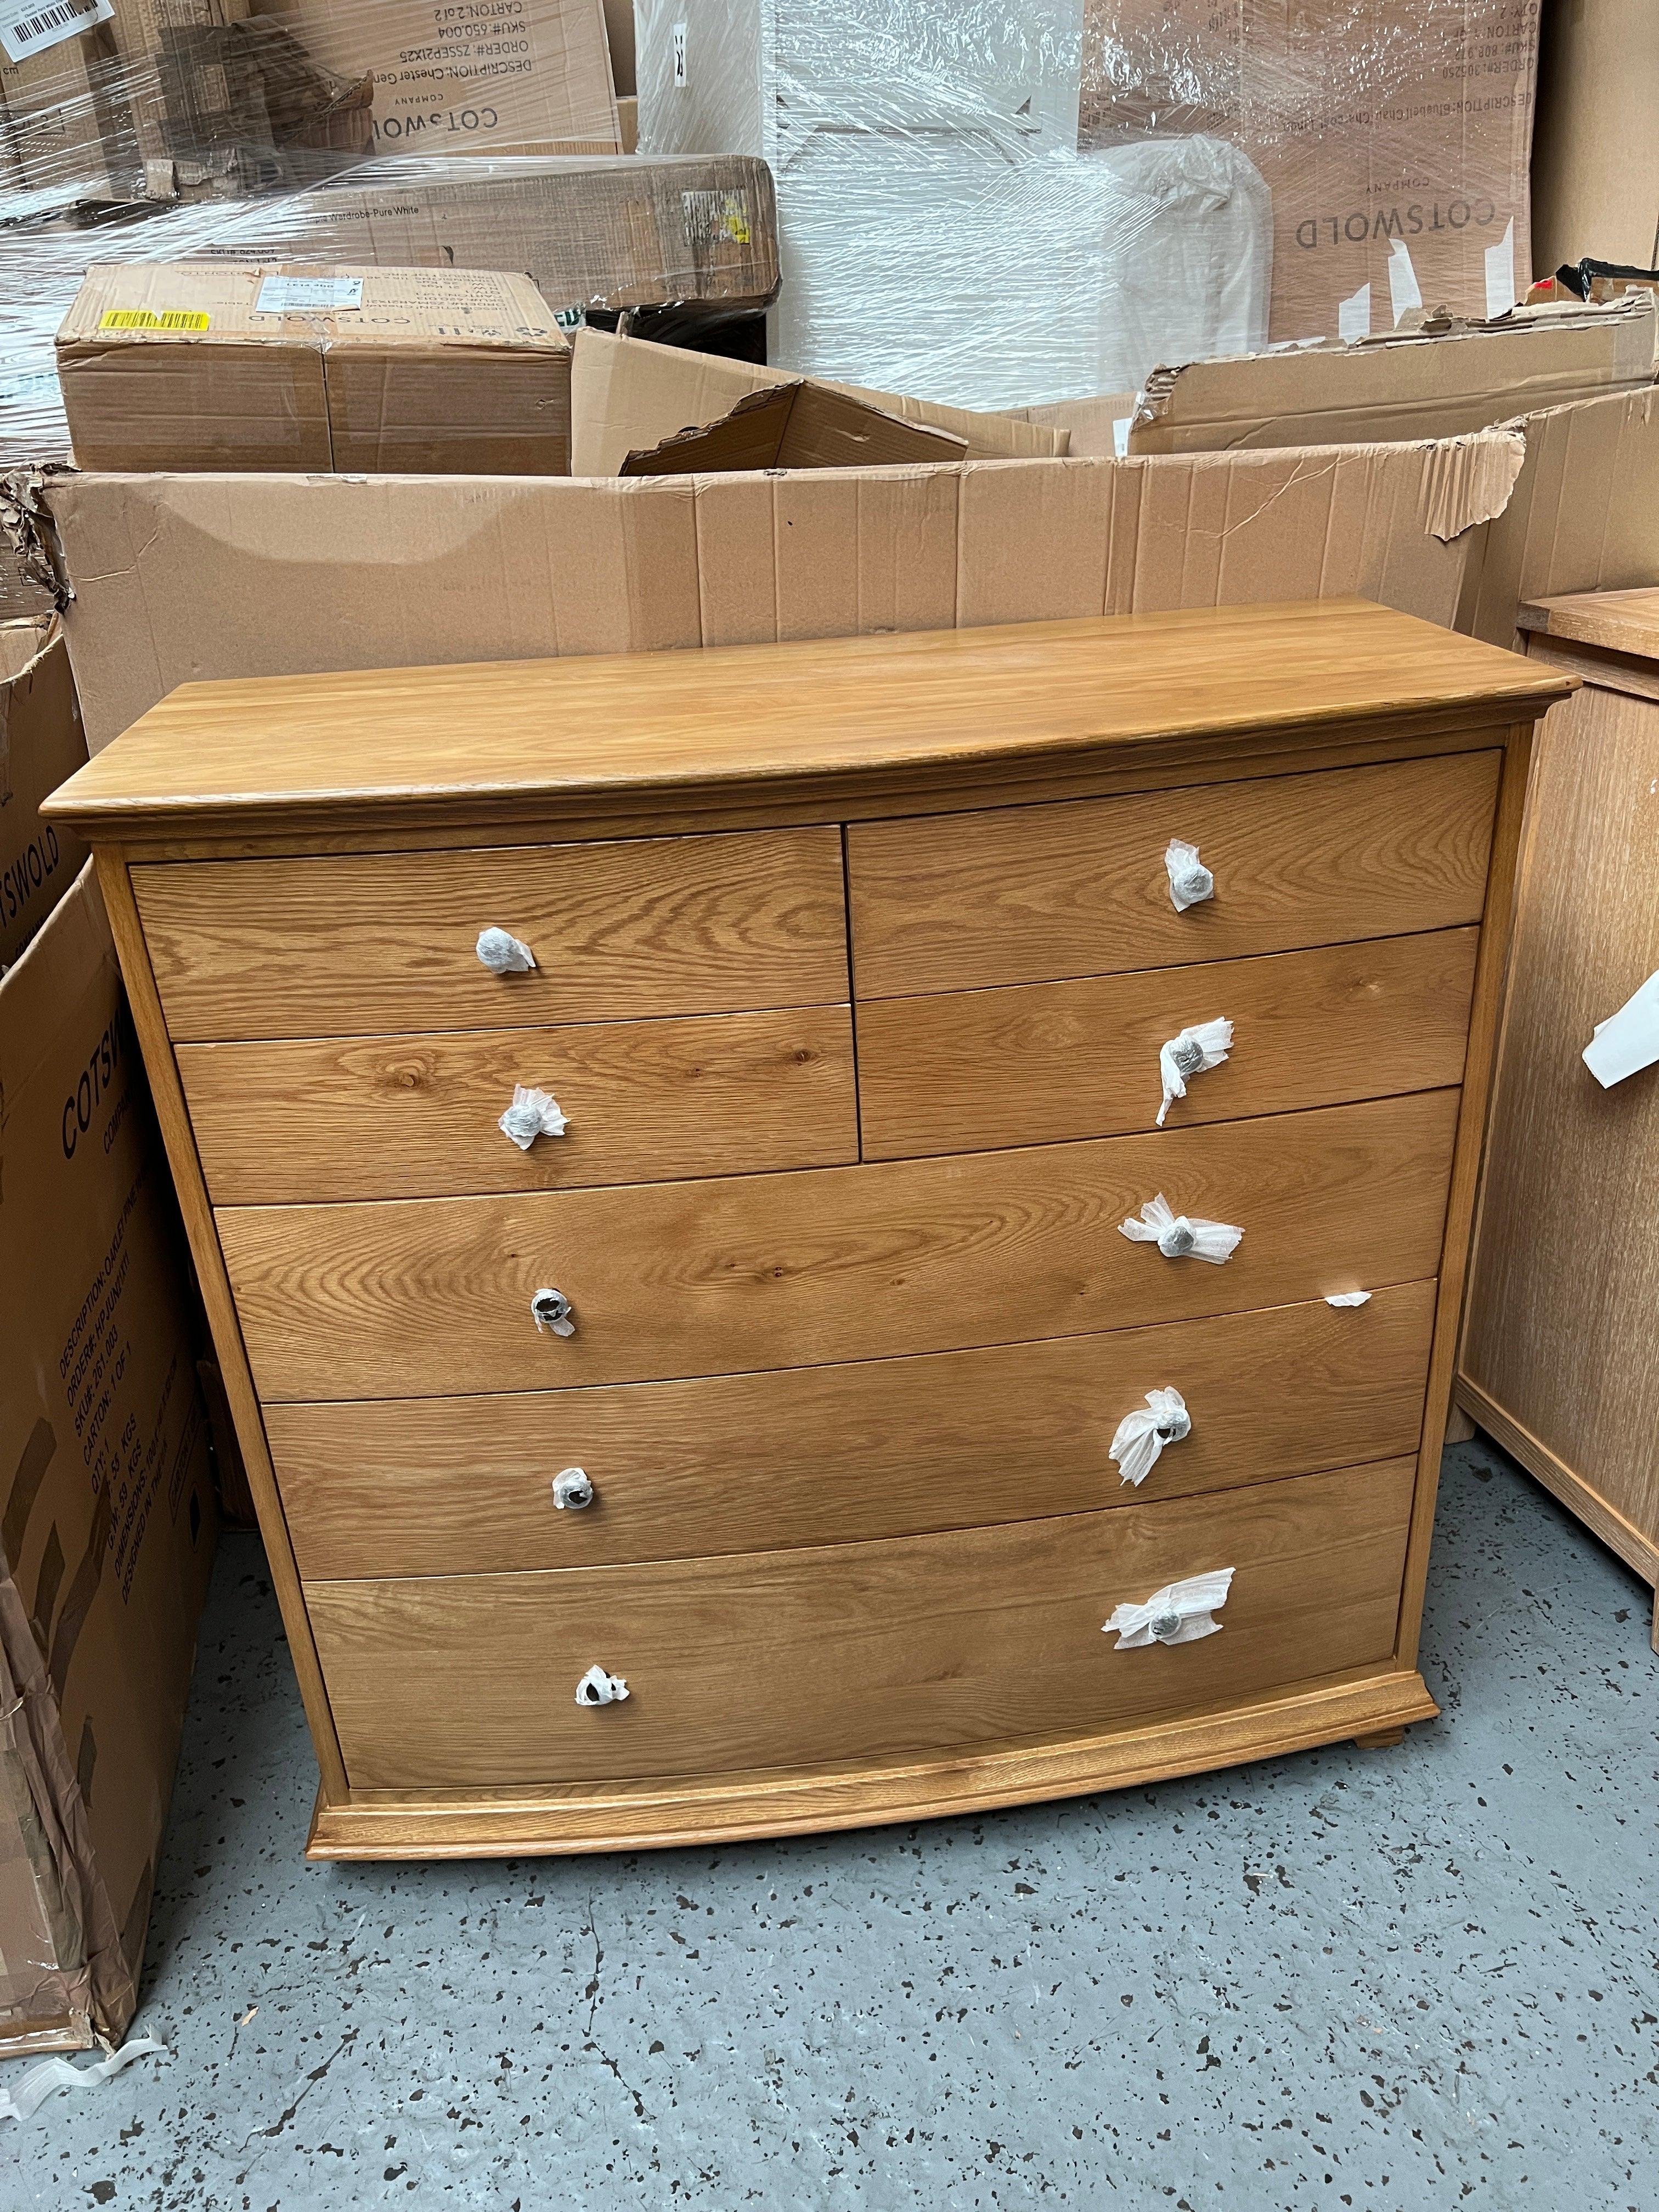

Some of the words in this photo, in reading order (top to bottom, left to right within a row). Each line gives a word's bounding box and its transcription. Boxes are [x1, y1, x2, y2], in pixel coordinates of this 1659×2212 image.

[434, 9, 442, 21] 2
[458, 7, 466, 20] 2
[438, 24, 487, 38] 650.004
[399, 44, 471, 63] ZSSEP21X25
[473, 40, 529, 57] ORDER#:
[400, 68, 444, 81] Chester
[447, 59, 532, 78] DESCRIPTION:
[394, 93, 443, 105] COMPANY
[1365, 176, 1430, 194] COMPANY
[393, 206, 419, 215] White
[1296, 197, 1496, 249] COTSWOLD
[59, 1271, 106, 1379] DESCRIPTION:
[66, 1334, 97, 1407] ORDER#:
[75, 1384, 95, 1437] SKU#:
[83, 1391, 111, 1466] CARTON:
[111, 1373, 117, 1392] 1
[115, 1349, 126, 1381] OF
[126, 1340, 132, 1356] 1
[121, 1412, 137, 1454] KGS
[91, 1449, 106, 1494] QTY:
[127, 1437, 142, 1480] KGS
[114, 1466, 147, 1579] DIMENSIONS:
[122, 1514, 146, 1606] DESIGNED
[144, 1496, 152, 1515] IN
